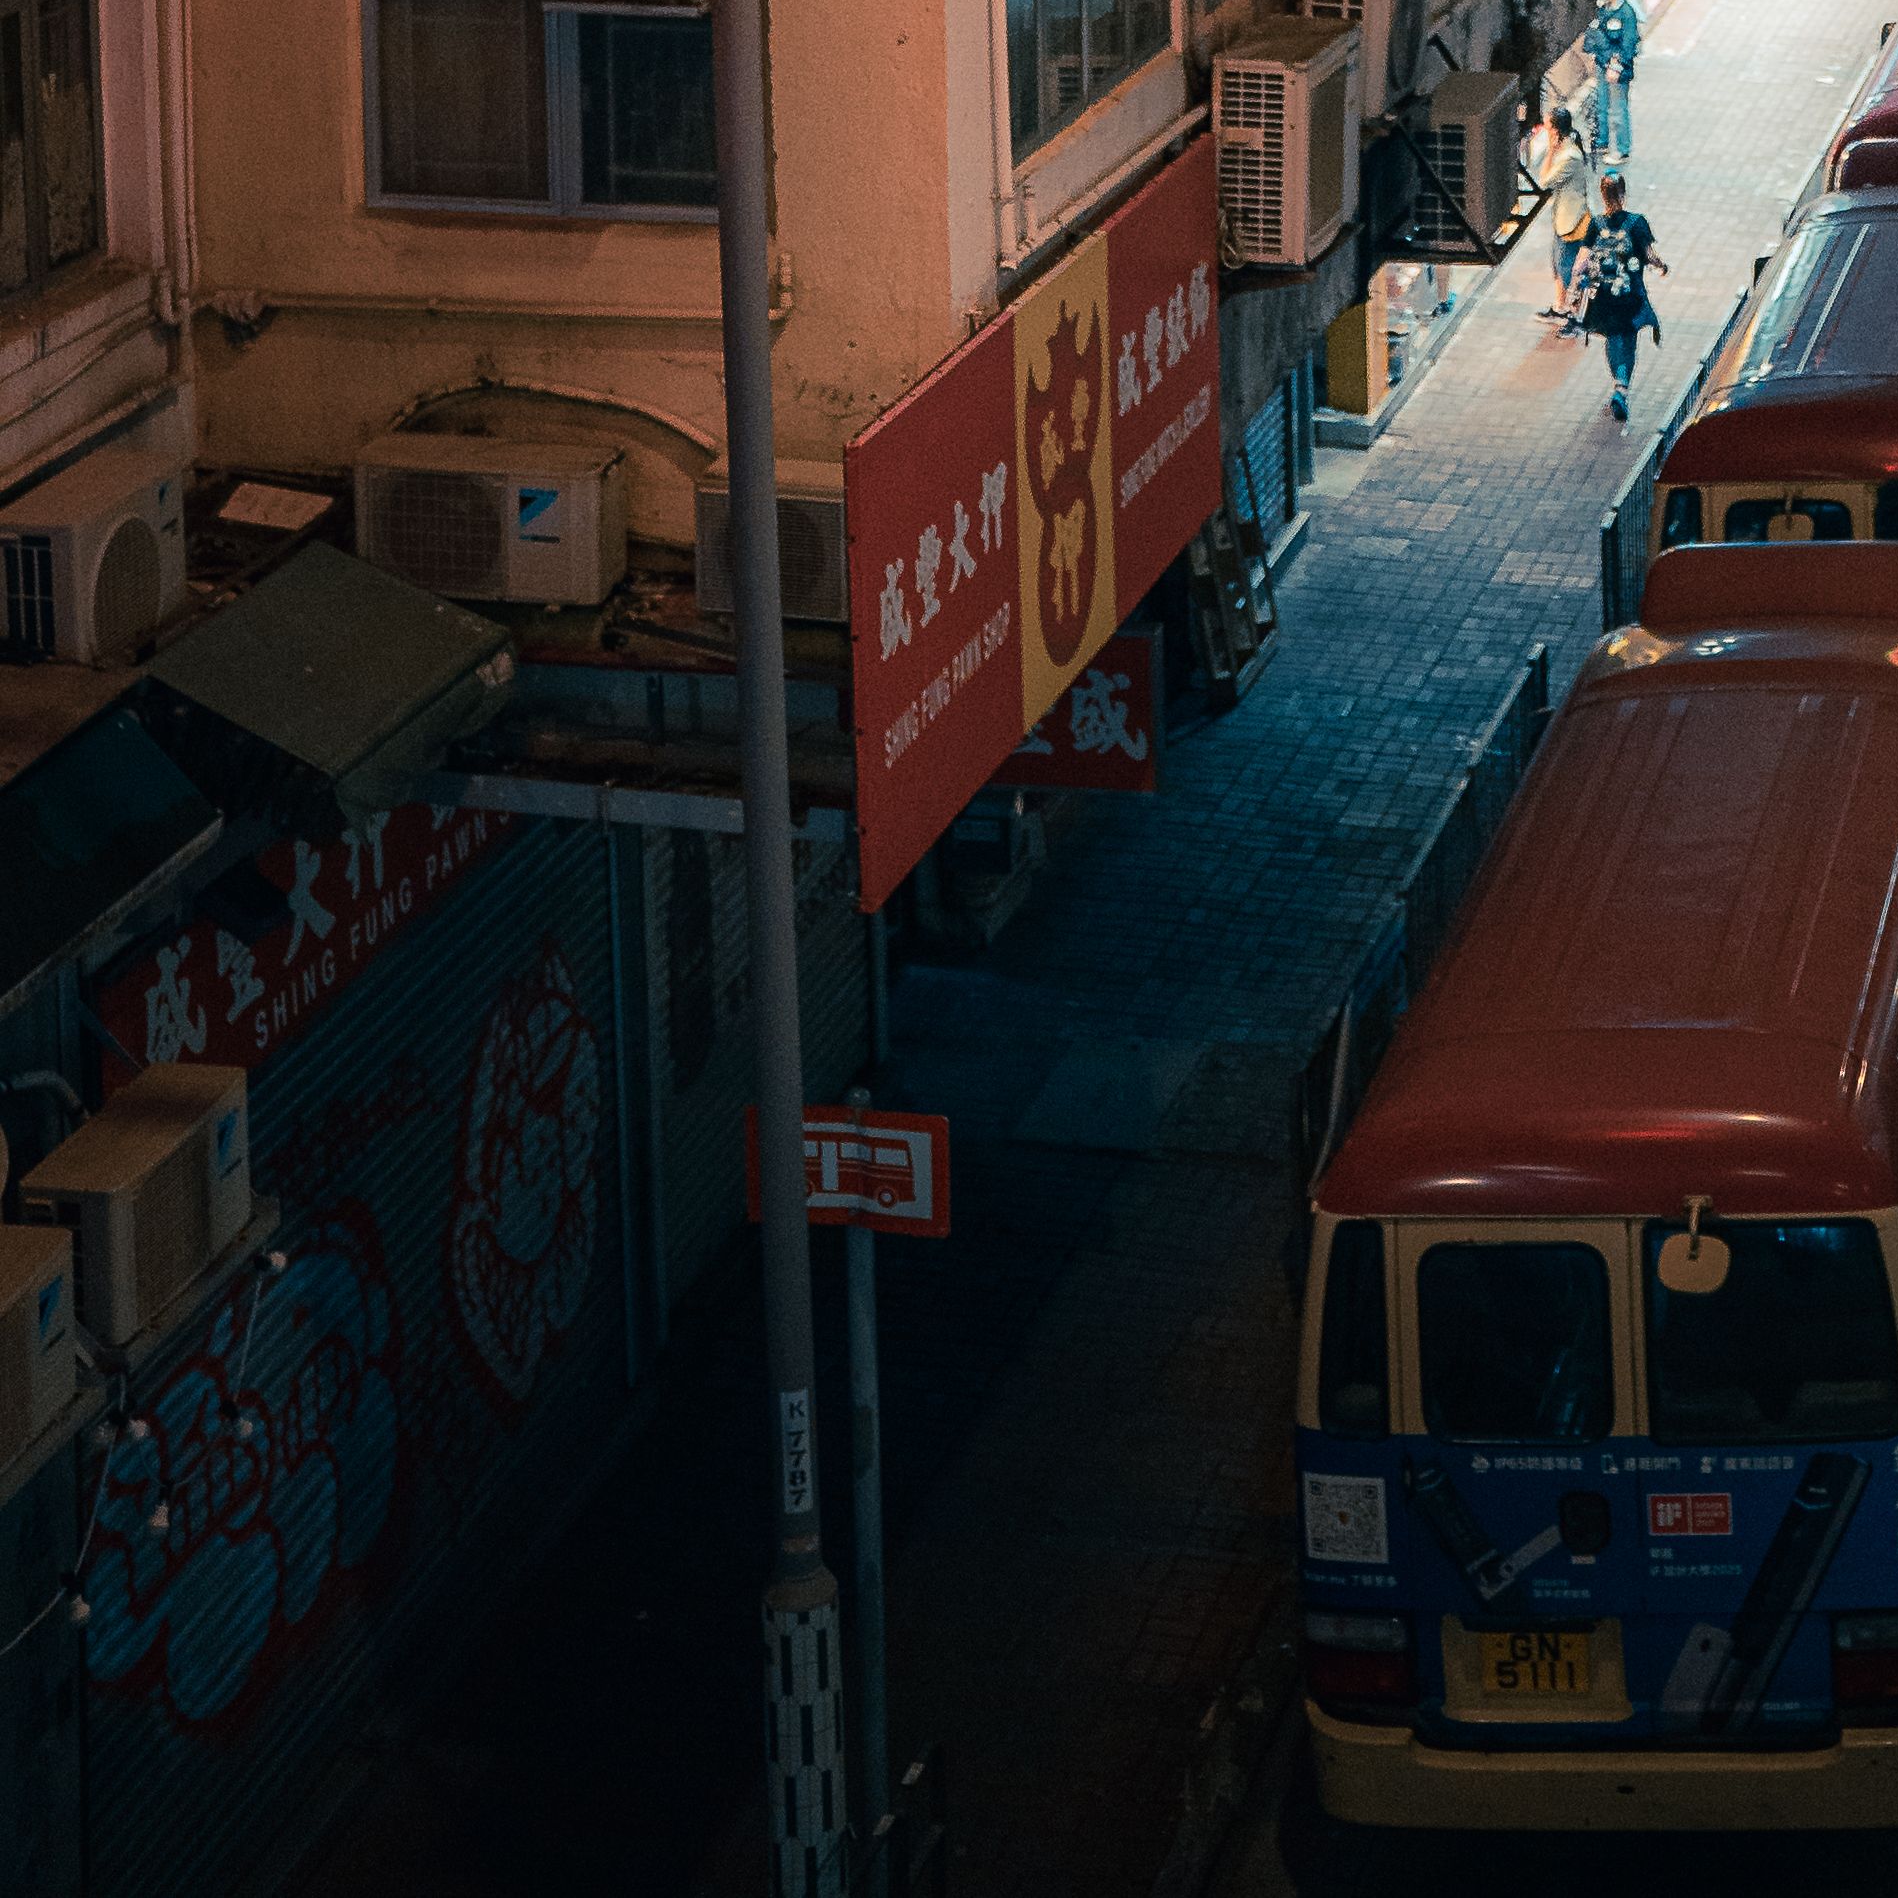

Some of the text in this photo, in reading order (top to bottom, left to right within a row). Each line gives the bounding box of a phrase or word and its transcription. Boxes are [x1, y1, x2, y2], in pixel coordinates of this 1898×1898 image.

[1050, 497, 1087, 624] 押
[883, 700, 919, 770] SHING
[920, 667, 951, 728] FUNG
[952, 642, 981, 695] PAWN
[253, 816, 488, 1052] SHING FUNG PAWN
[1496, 1661, 1576, 1689] 5111
[1510, 1635, 1560, 1661] GN
